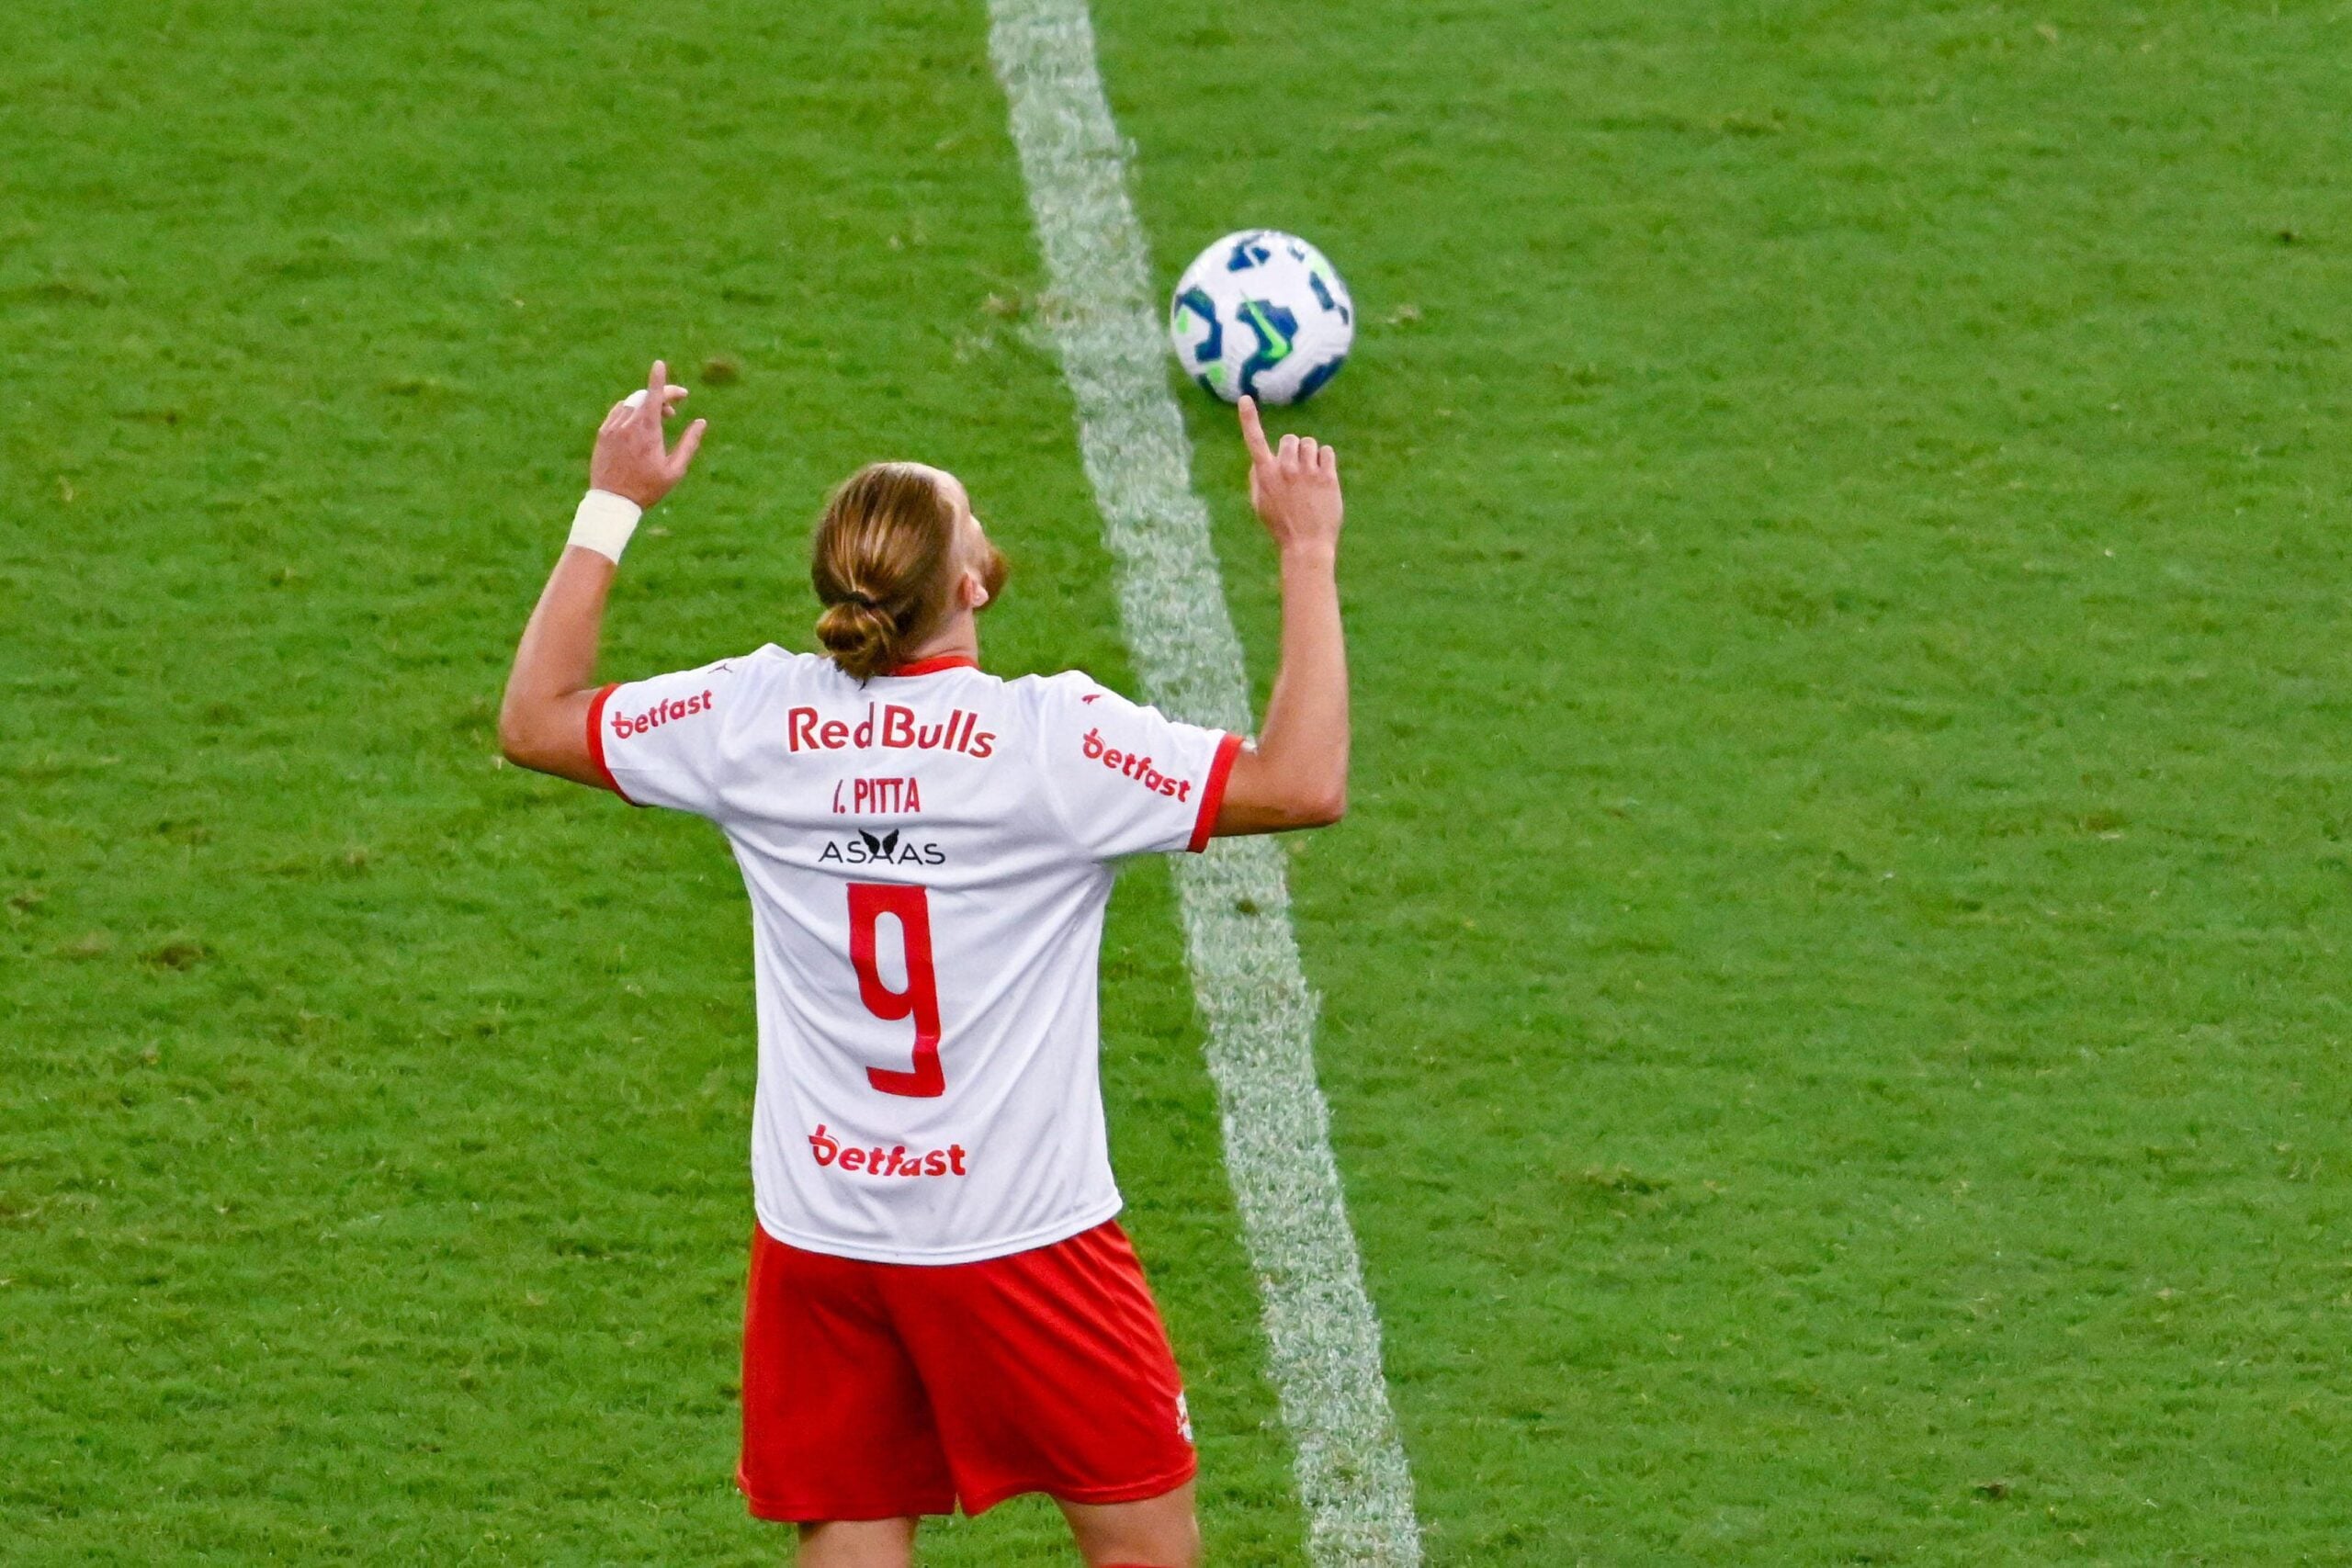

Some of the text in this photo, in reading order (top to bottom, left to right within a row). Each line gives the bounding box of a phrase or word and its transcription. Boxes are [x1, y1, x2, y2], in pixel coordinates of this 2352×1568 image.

[610, 690, 713, 739] betfast
[1082, 728, 1192, 803] betfast
[854, 777, 921, 814] PITTA
[846, 882, 946, 1098] 9
[808, 1124, 967, 1177] betfast
